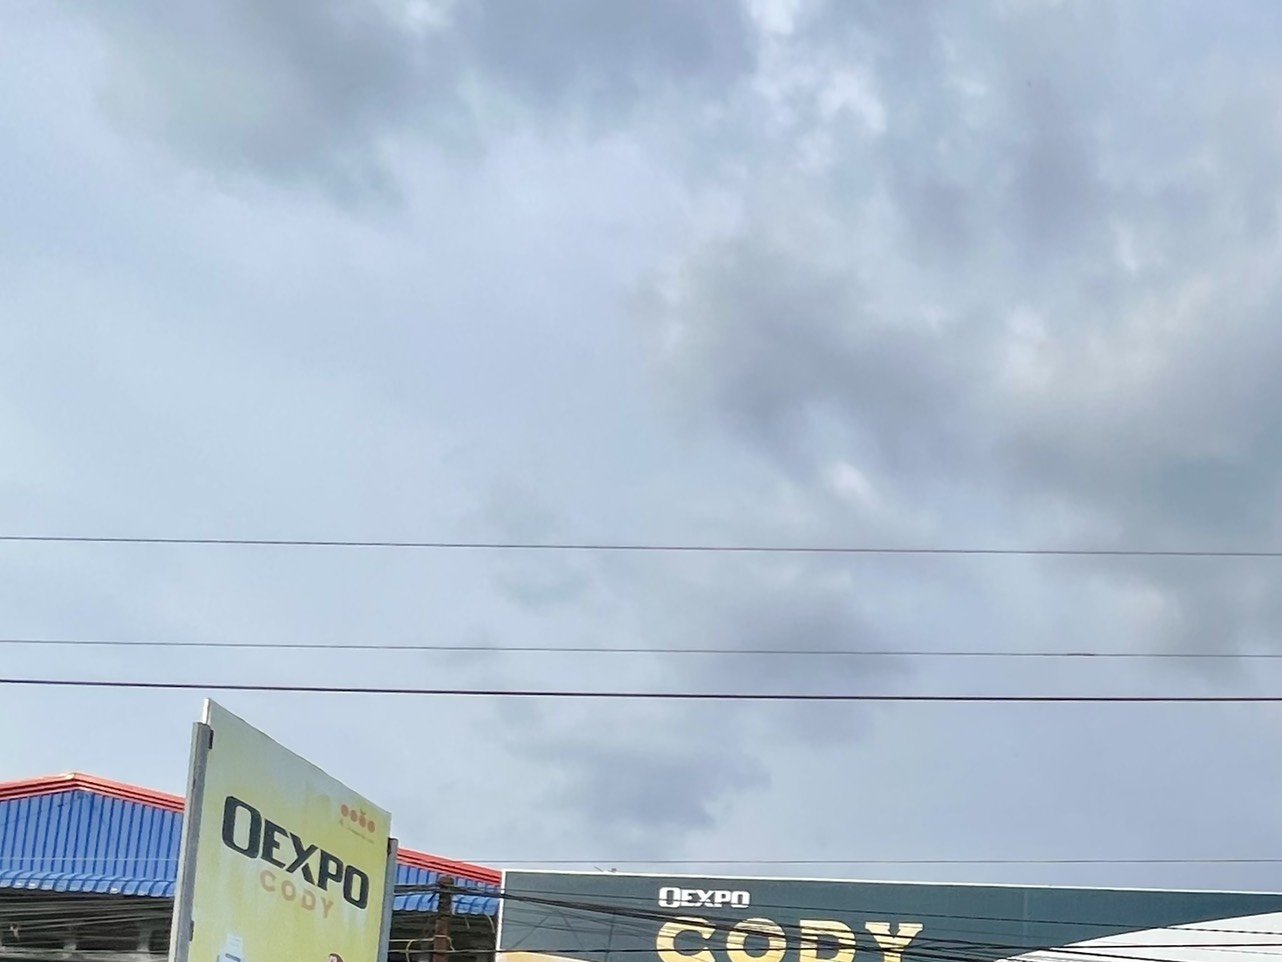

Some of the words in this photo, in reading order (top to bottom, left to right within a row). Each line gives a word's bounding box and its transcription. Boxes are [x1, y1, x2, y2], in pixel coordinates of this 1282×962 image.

[222, 796, 369, 909] OEXPO
[260, 869, 333, 919] CODY
[658, 887, 750, 908] OEXPO
